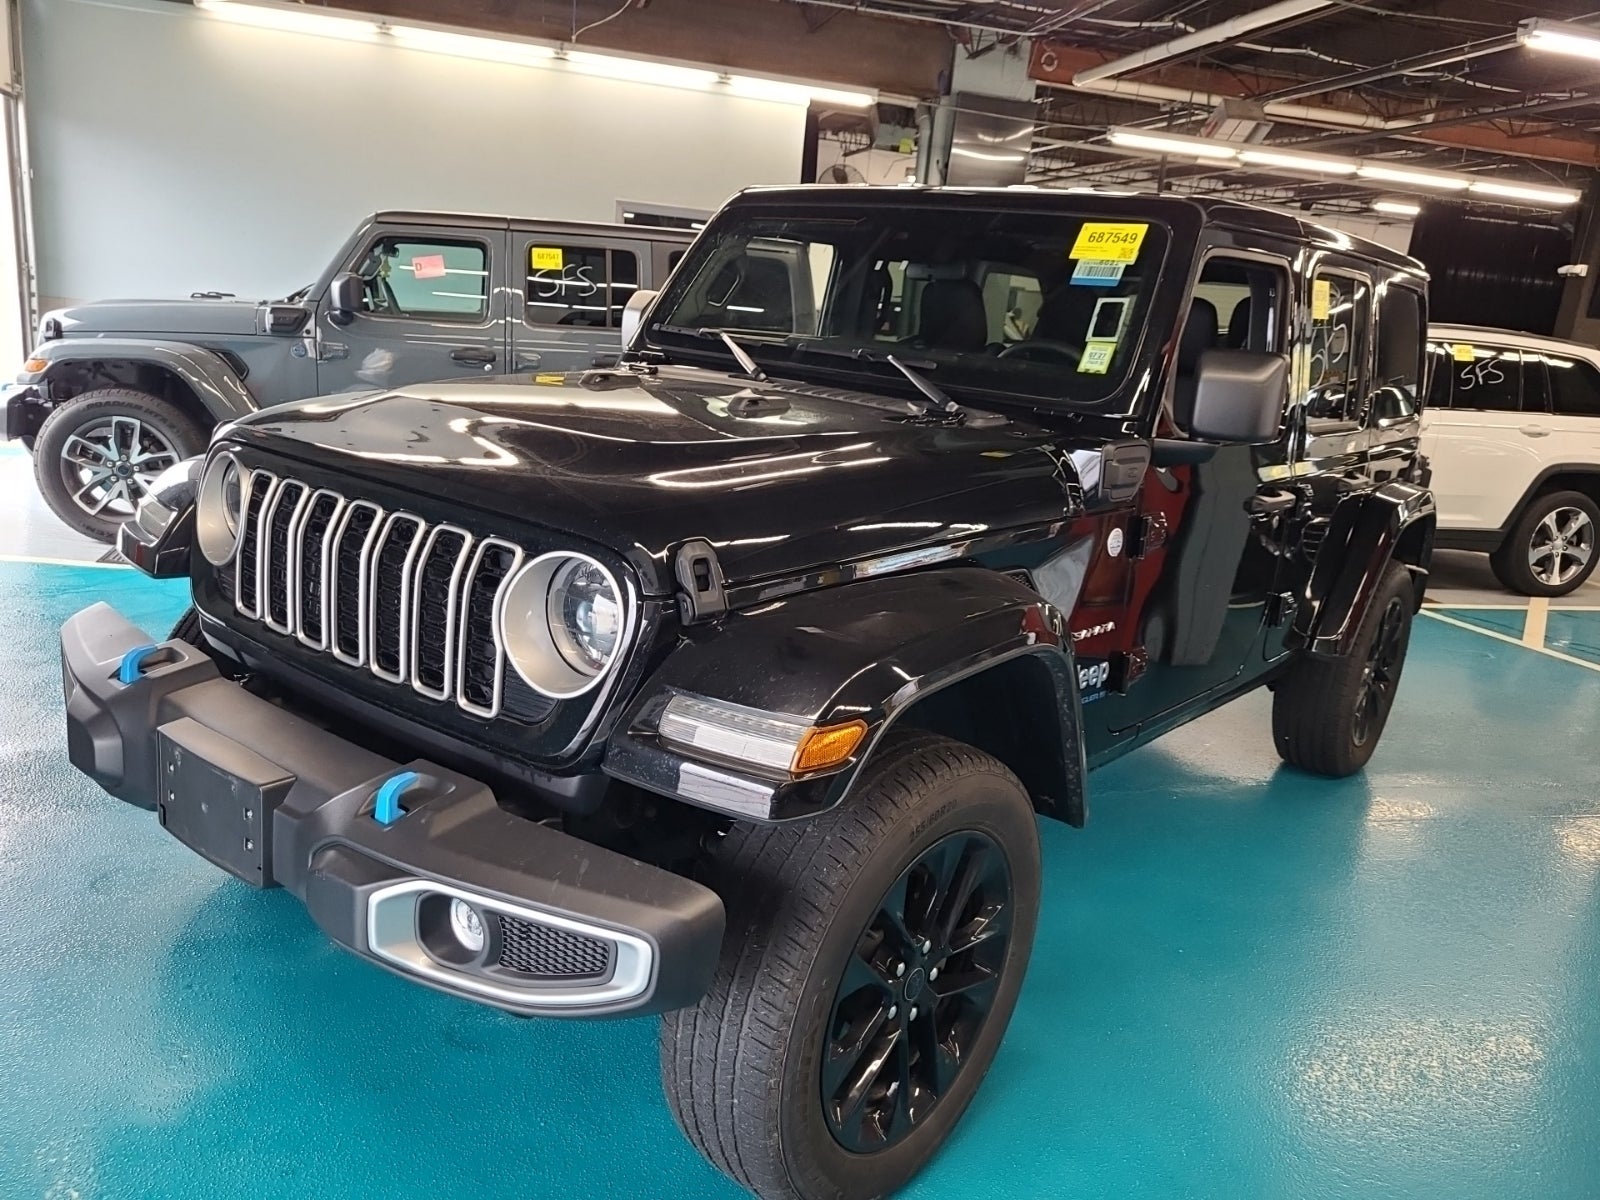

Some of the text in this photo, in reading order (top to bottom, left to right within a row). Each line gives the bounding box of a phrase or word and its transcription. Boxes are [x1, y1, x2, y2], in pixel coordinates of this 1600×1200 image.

[1087, 231, 1139, 244] 687549
[535, 263, 598, 298] SFS
[1459, 358, 1505, 389] SFS
